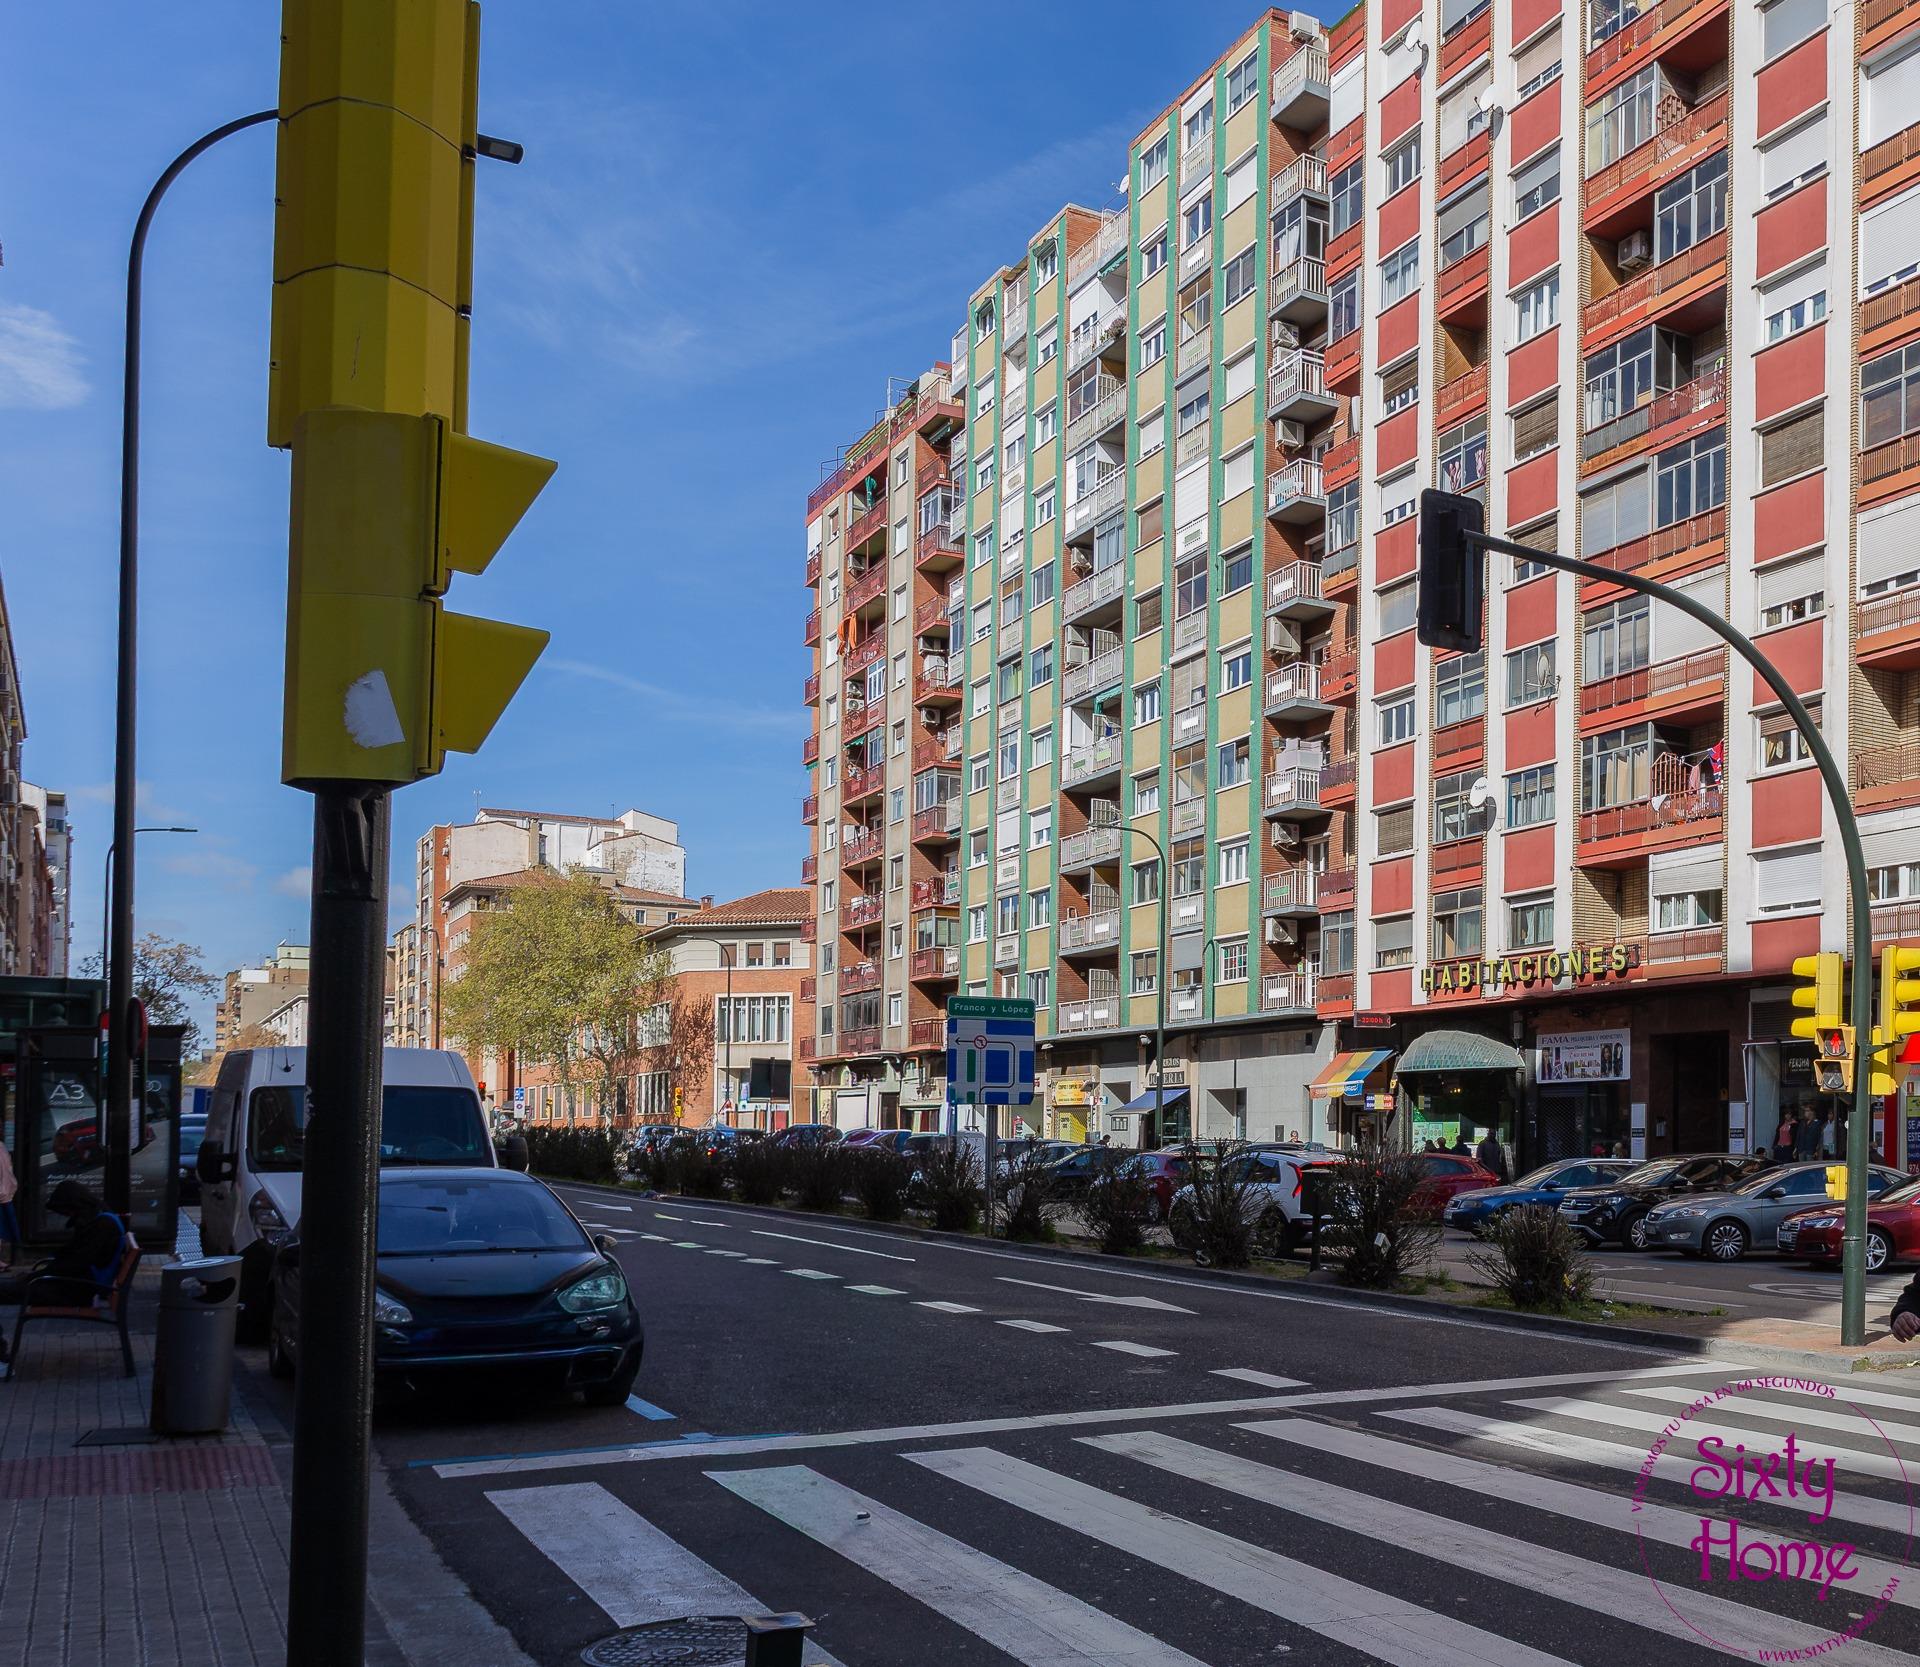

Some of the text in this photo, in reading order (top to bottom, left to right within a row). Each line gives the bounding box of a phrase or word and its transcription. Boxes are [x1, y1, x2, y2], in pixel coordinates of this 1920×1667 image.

[1421, 944, 1627, 991] HABITACIONES
[954, 1002, 1029, 1013] Franco y López
[1542, 1035, 1569, 1045] FAMA
[1150, 1072, 1184, 1085] JOERIA
[50, 1084, 85, 1100] A3
[1908, 1163, 1920, 1174] 976
